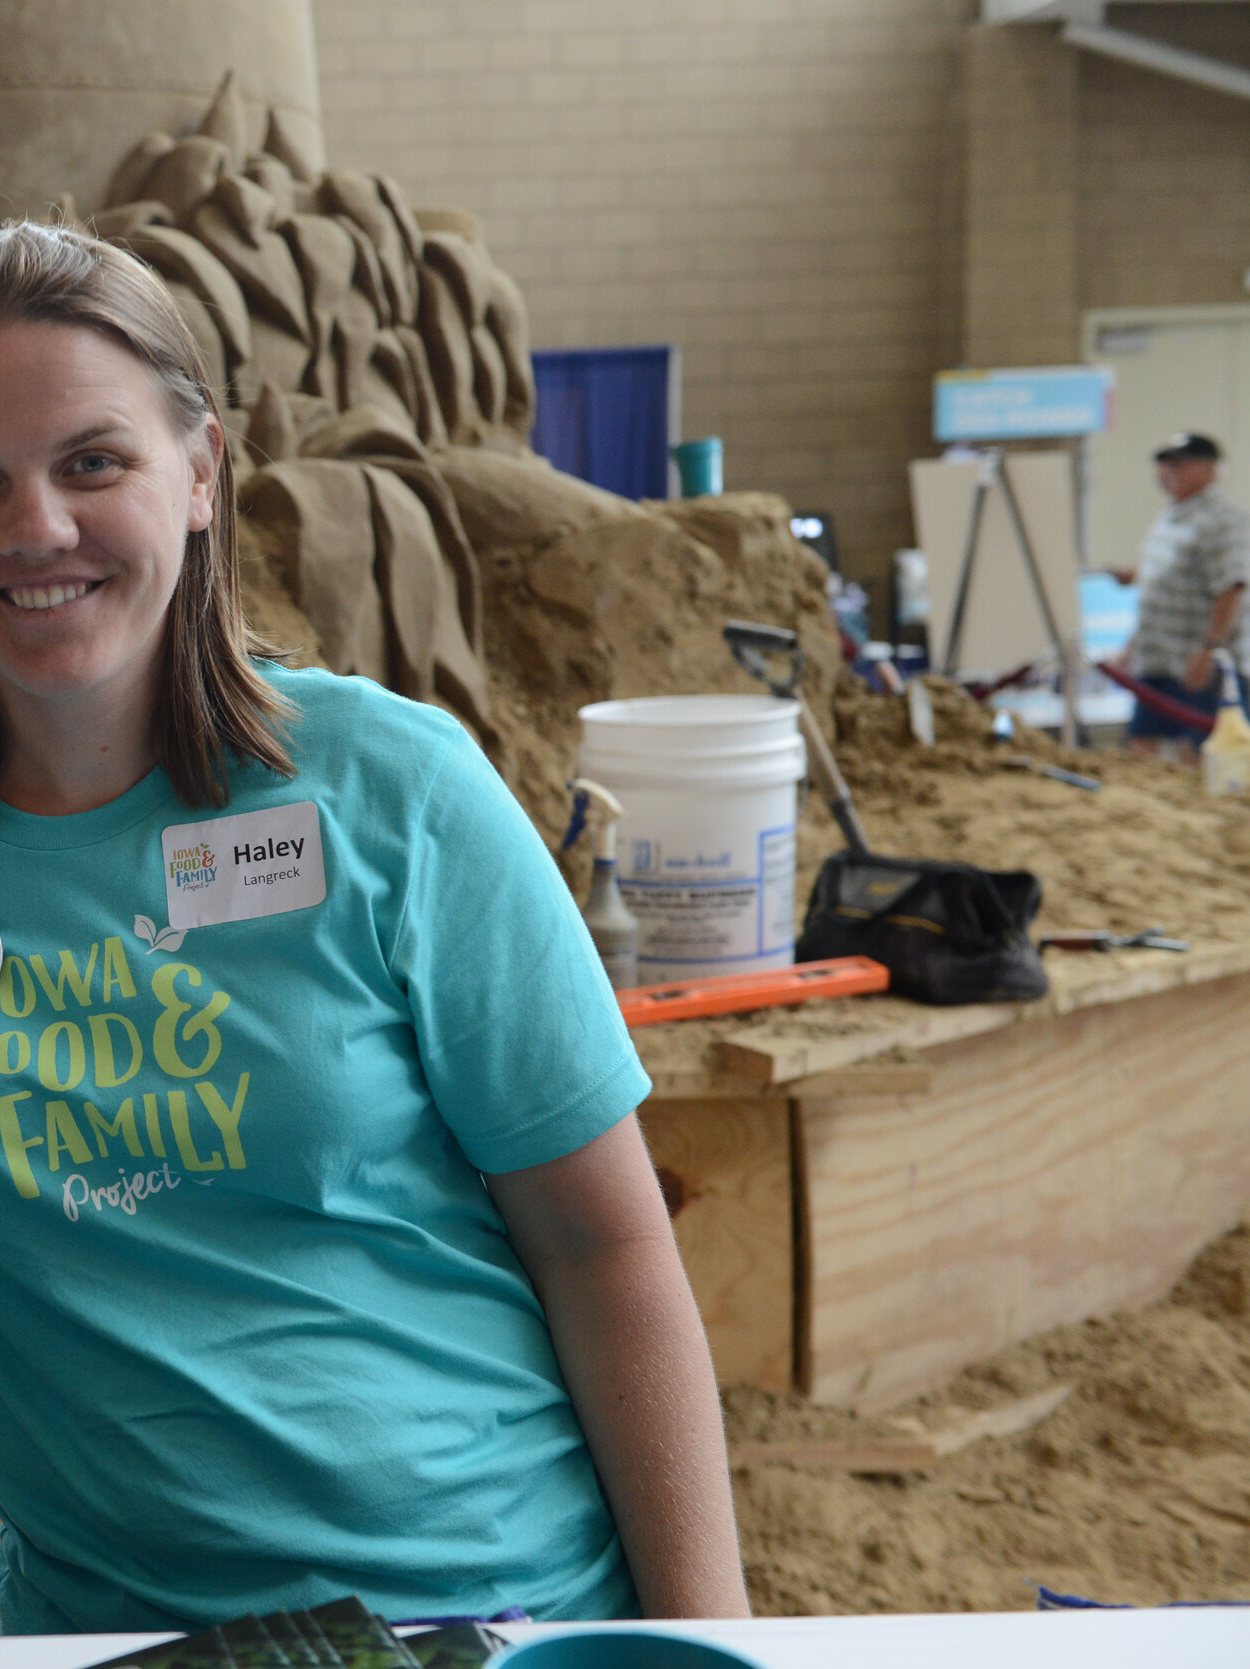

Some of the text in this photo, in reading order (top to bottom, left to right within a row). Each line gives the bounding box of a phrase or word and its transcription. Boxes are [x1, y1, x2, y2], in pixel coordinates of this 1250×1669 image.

[173, 846, 201, 860] IOWA
[202, 850, 216, 868] &
[233, 837, 305, 865] Haley
[176, 866, 218, 887] FAMILY
[244, 866, 300, 886] Langreck
[151, 963, 231, 1078] &
[62, 1162, 181, 1222] Project
